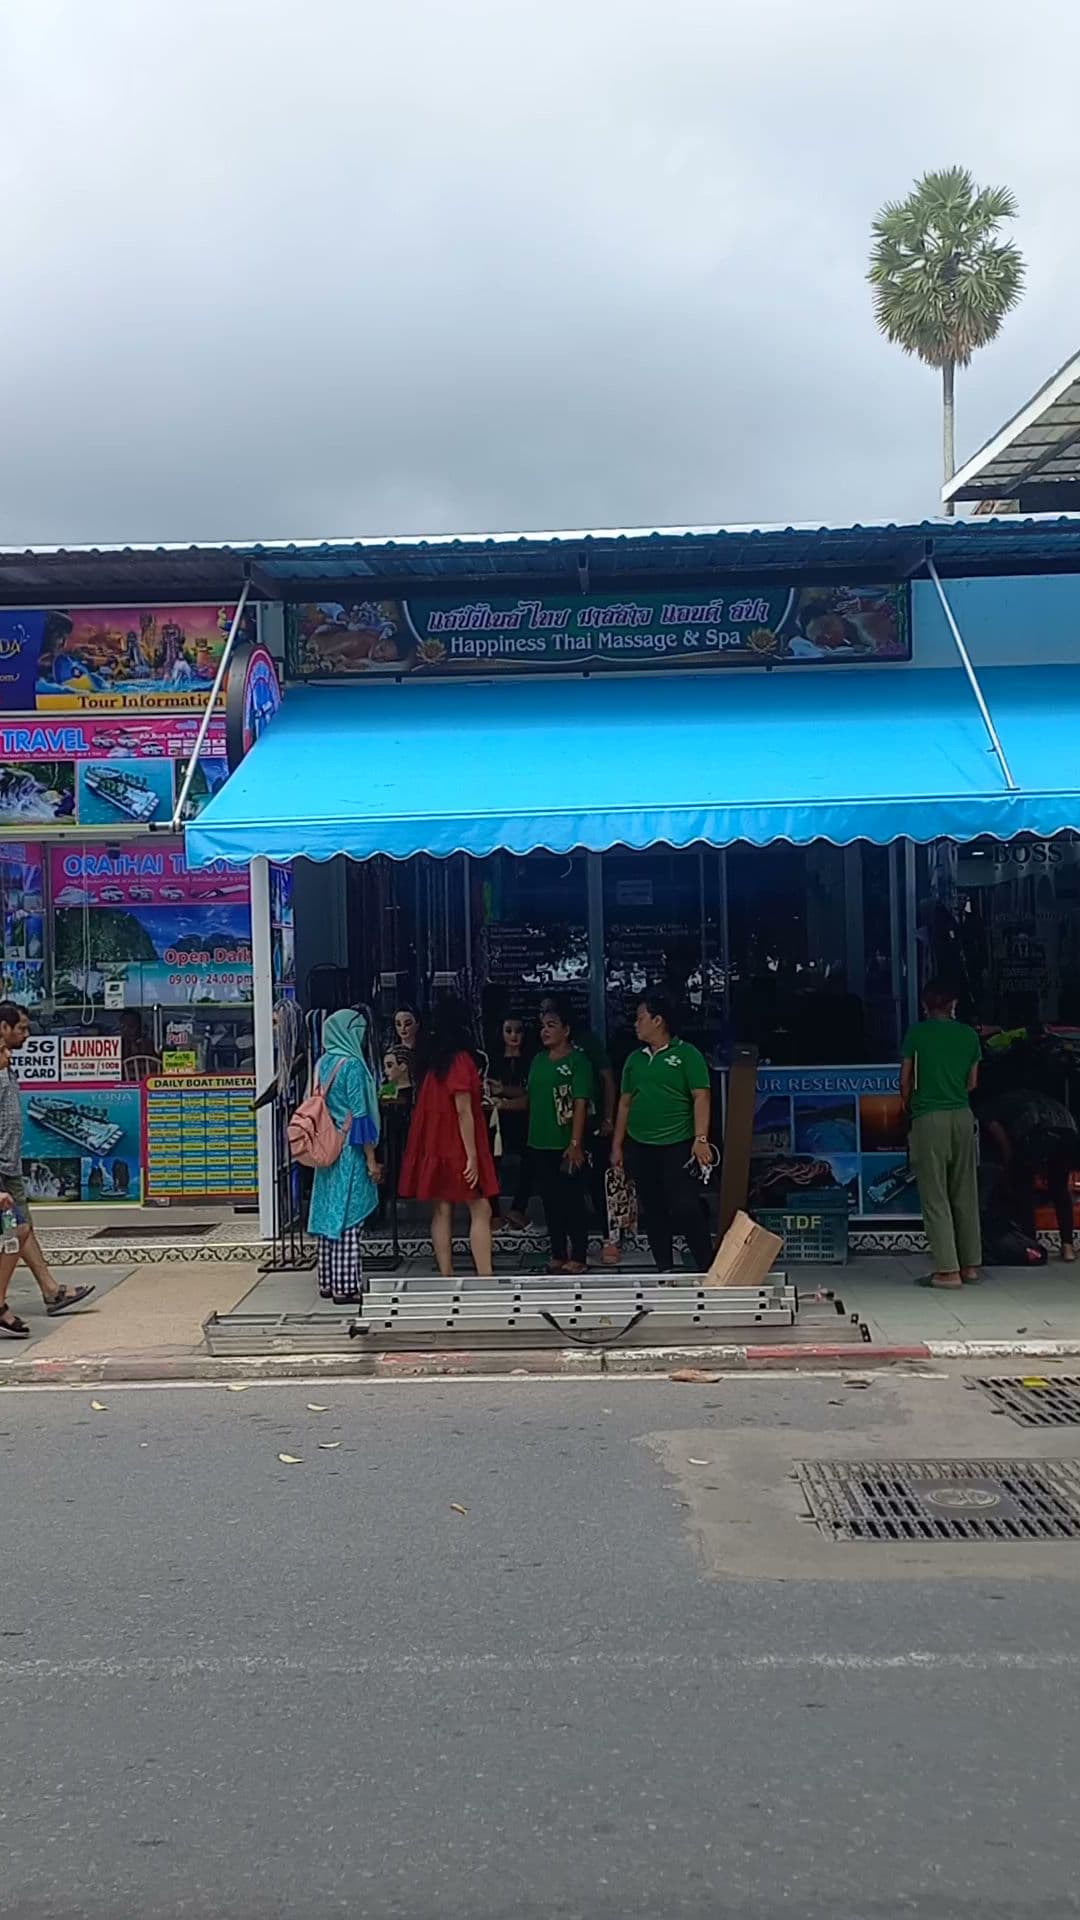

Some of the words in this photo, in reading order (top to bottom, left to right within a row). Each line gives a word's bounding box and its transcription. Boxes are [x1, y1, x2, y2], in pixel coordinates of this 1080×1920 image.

[518, 600, 571, 628] ไทย
[451, 634, 546, 657] Happiness
[552, 632, 592, 650] Thai
[598, 631, 677, 652] Massage
[683, 630, 700, 647] &
[705, 628, 741, 650] Spa
[77, 695, 118, 709] Tour
[122, 693, 224, 708] Information
[1, 728, 90, 752] TRAVEL
[994, 844, 1062, 863] BOSS
[64, 853, 162, 876] ORATHAI
[164, 948, 210, 968] Open
[26, 1041, 55, 1053] 5G
[63, 1040, 120, 1057] LAUNDRY
[9, 1056, 56, 1067] TERNET
[24, 1068, 56, 1079] CARD
[154, 1079, 184, 1088] DAILY
[186, 1079, 215, 1088] BOAT
[216, 1077, 256, 1087] TIMETA
[788, 1077, 902, 1091] RESERVATIO
[782, 1215, 822, 1230] TDF
